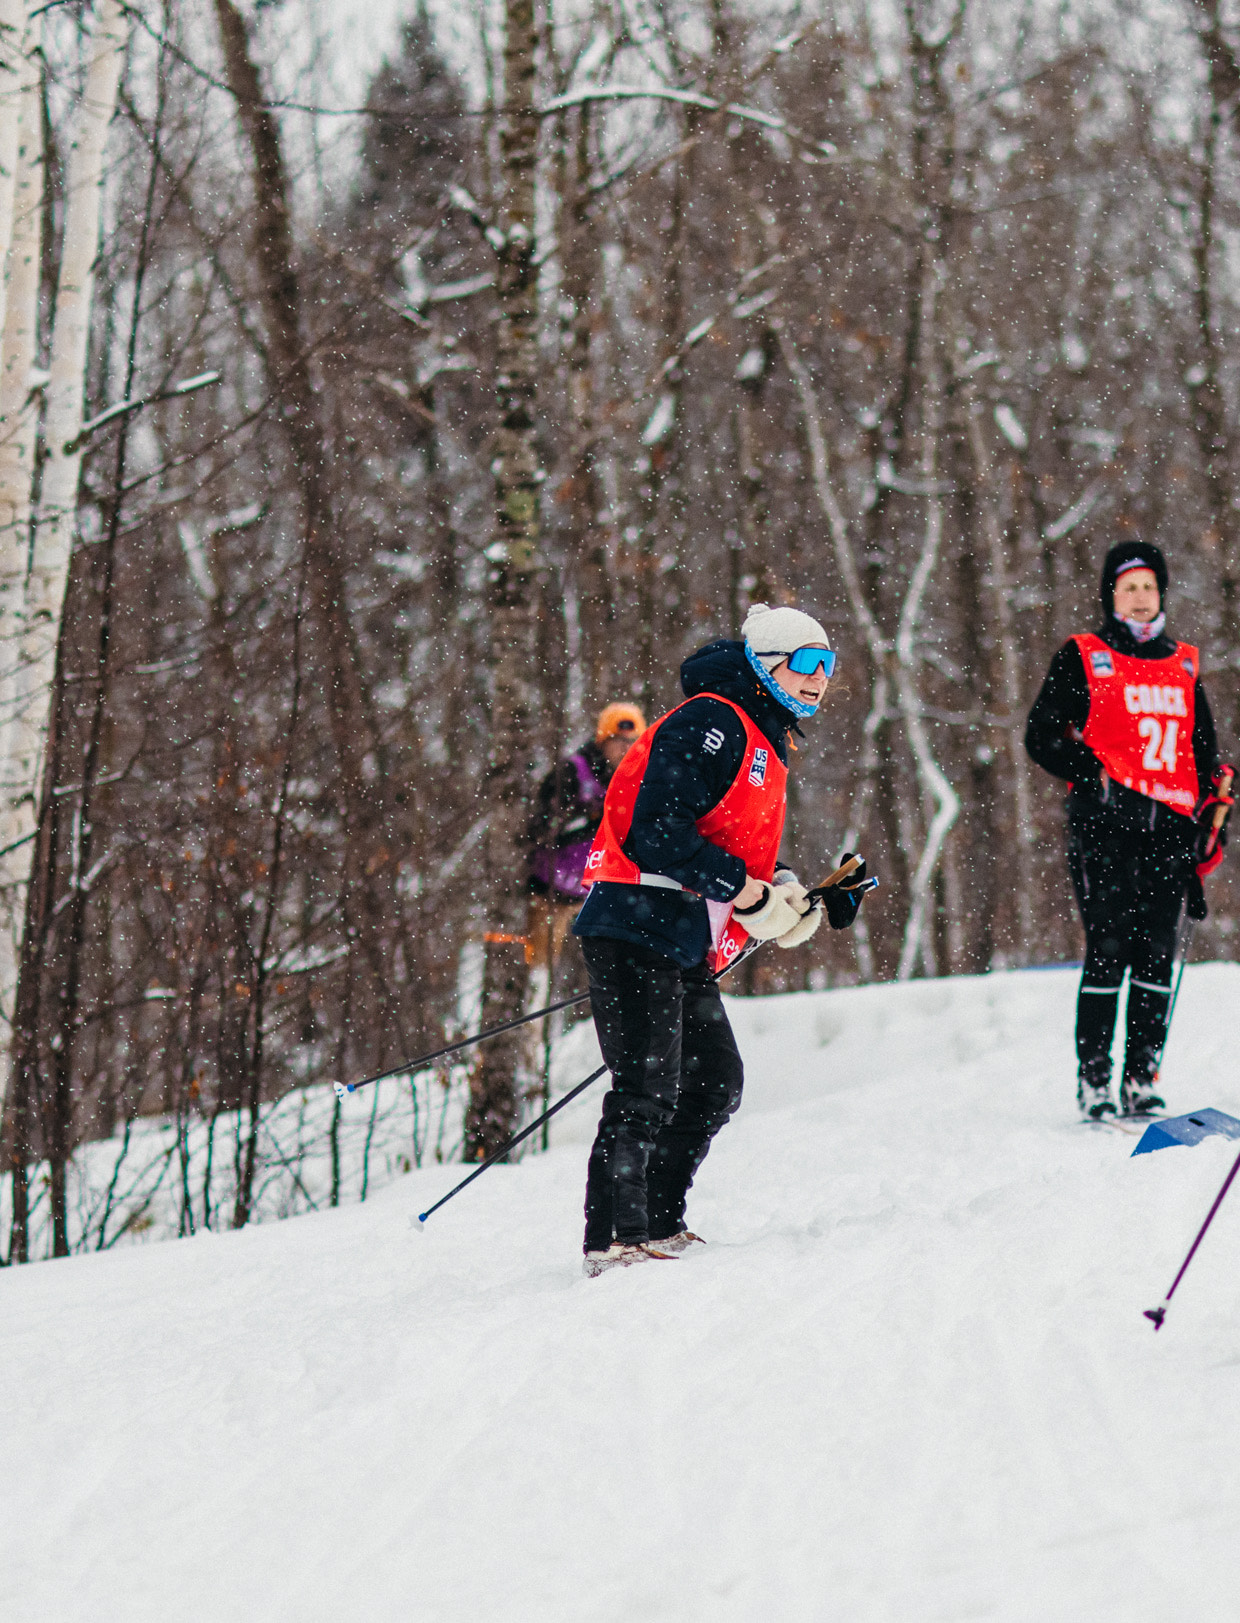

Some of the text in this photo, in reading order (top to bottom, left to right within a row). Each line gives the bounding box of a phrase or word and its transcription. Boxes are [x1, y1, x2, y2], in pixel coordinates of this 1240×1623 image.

[1123, 684, 1188, 717] COACH
[755, 748, 767, 763] US
[1138, 717, 1179, 774] 24
